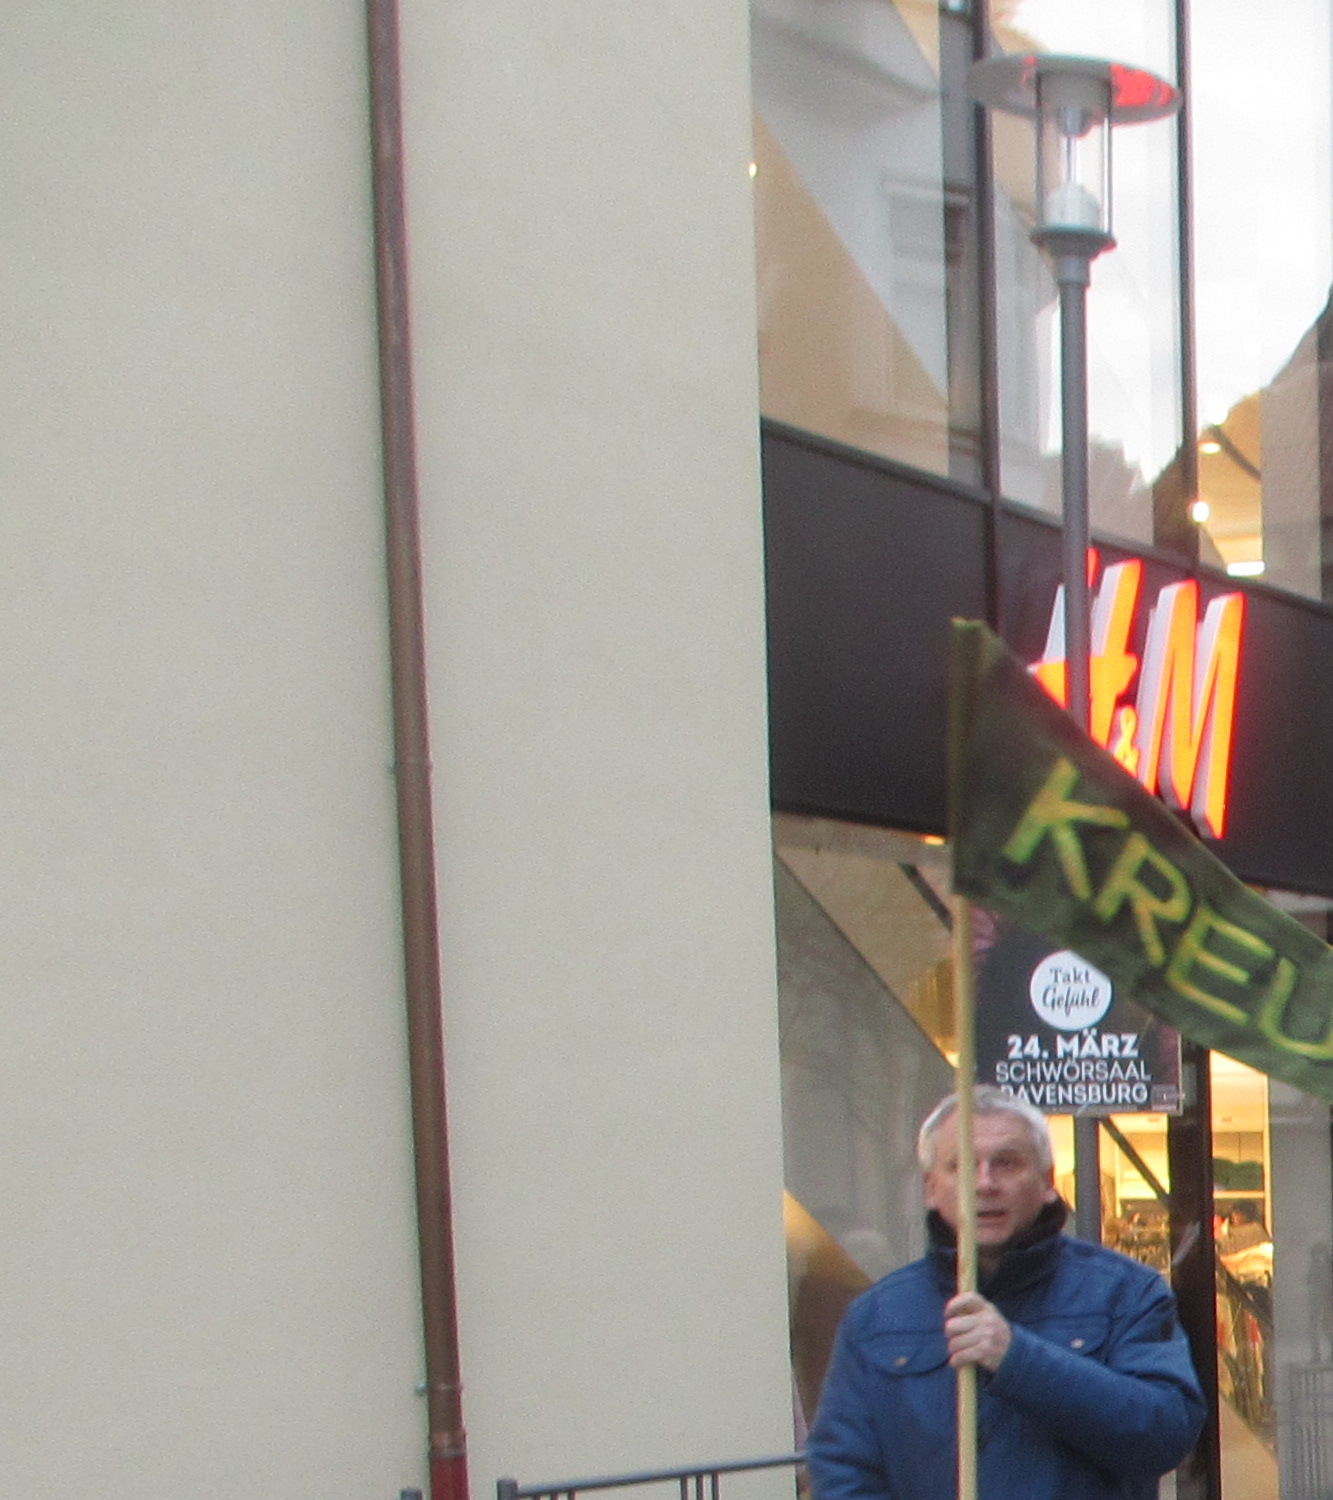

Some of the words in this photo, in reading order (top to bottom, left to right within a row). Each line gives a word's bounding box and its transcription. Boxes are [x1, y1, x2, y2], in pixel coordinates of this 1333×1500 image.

[1050, 967, 1091, 984] Takt
[1007, 1033, 1049, 1060] 24.
[1056, 1028, 1139, 1059] MÄRZ
[995, 1059, 1152, 1083] SCHWÖRSAAL
